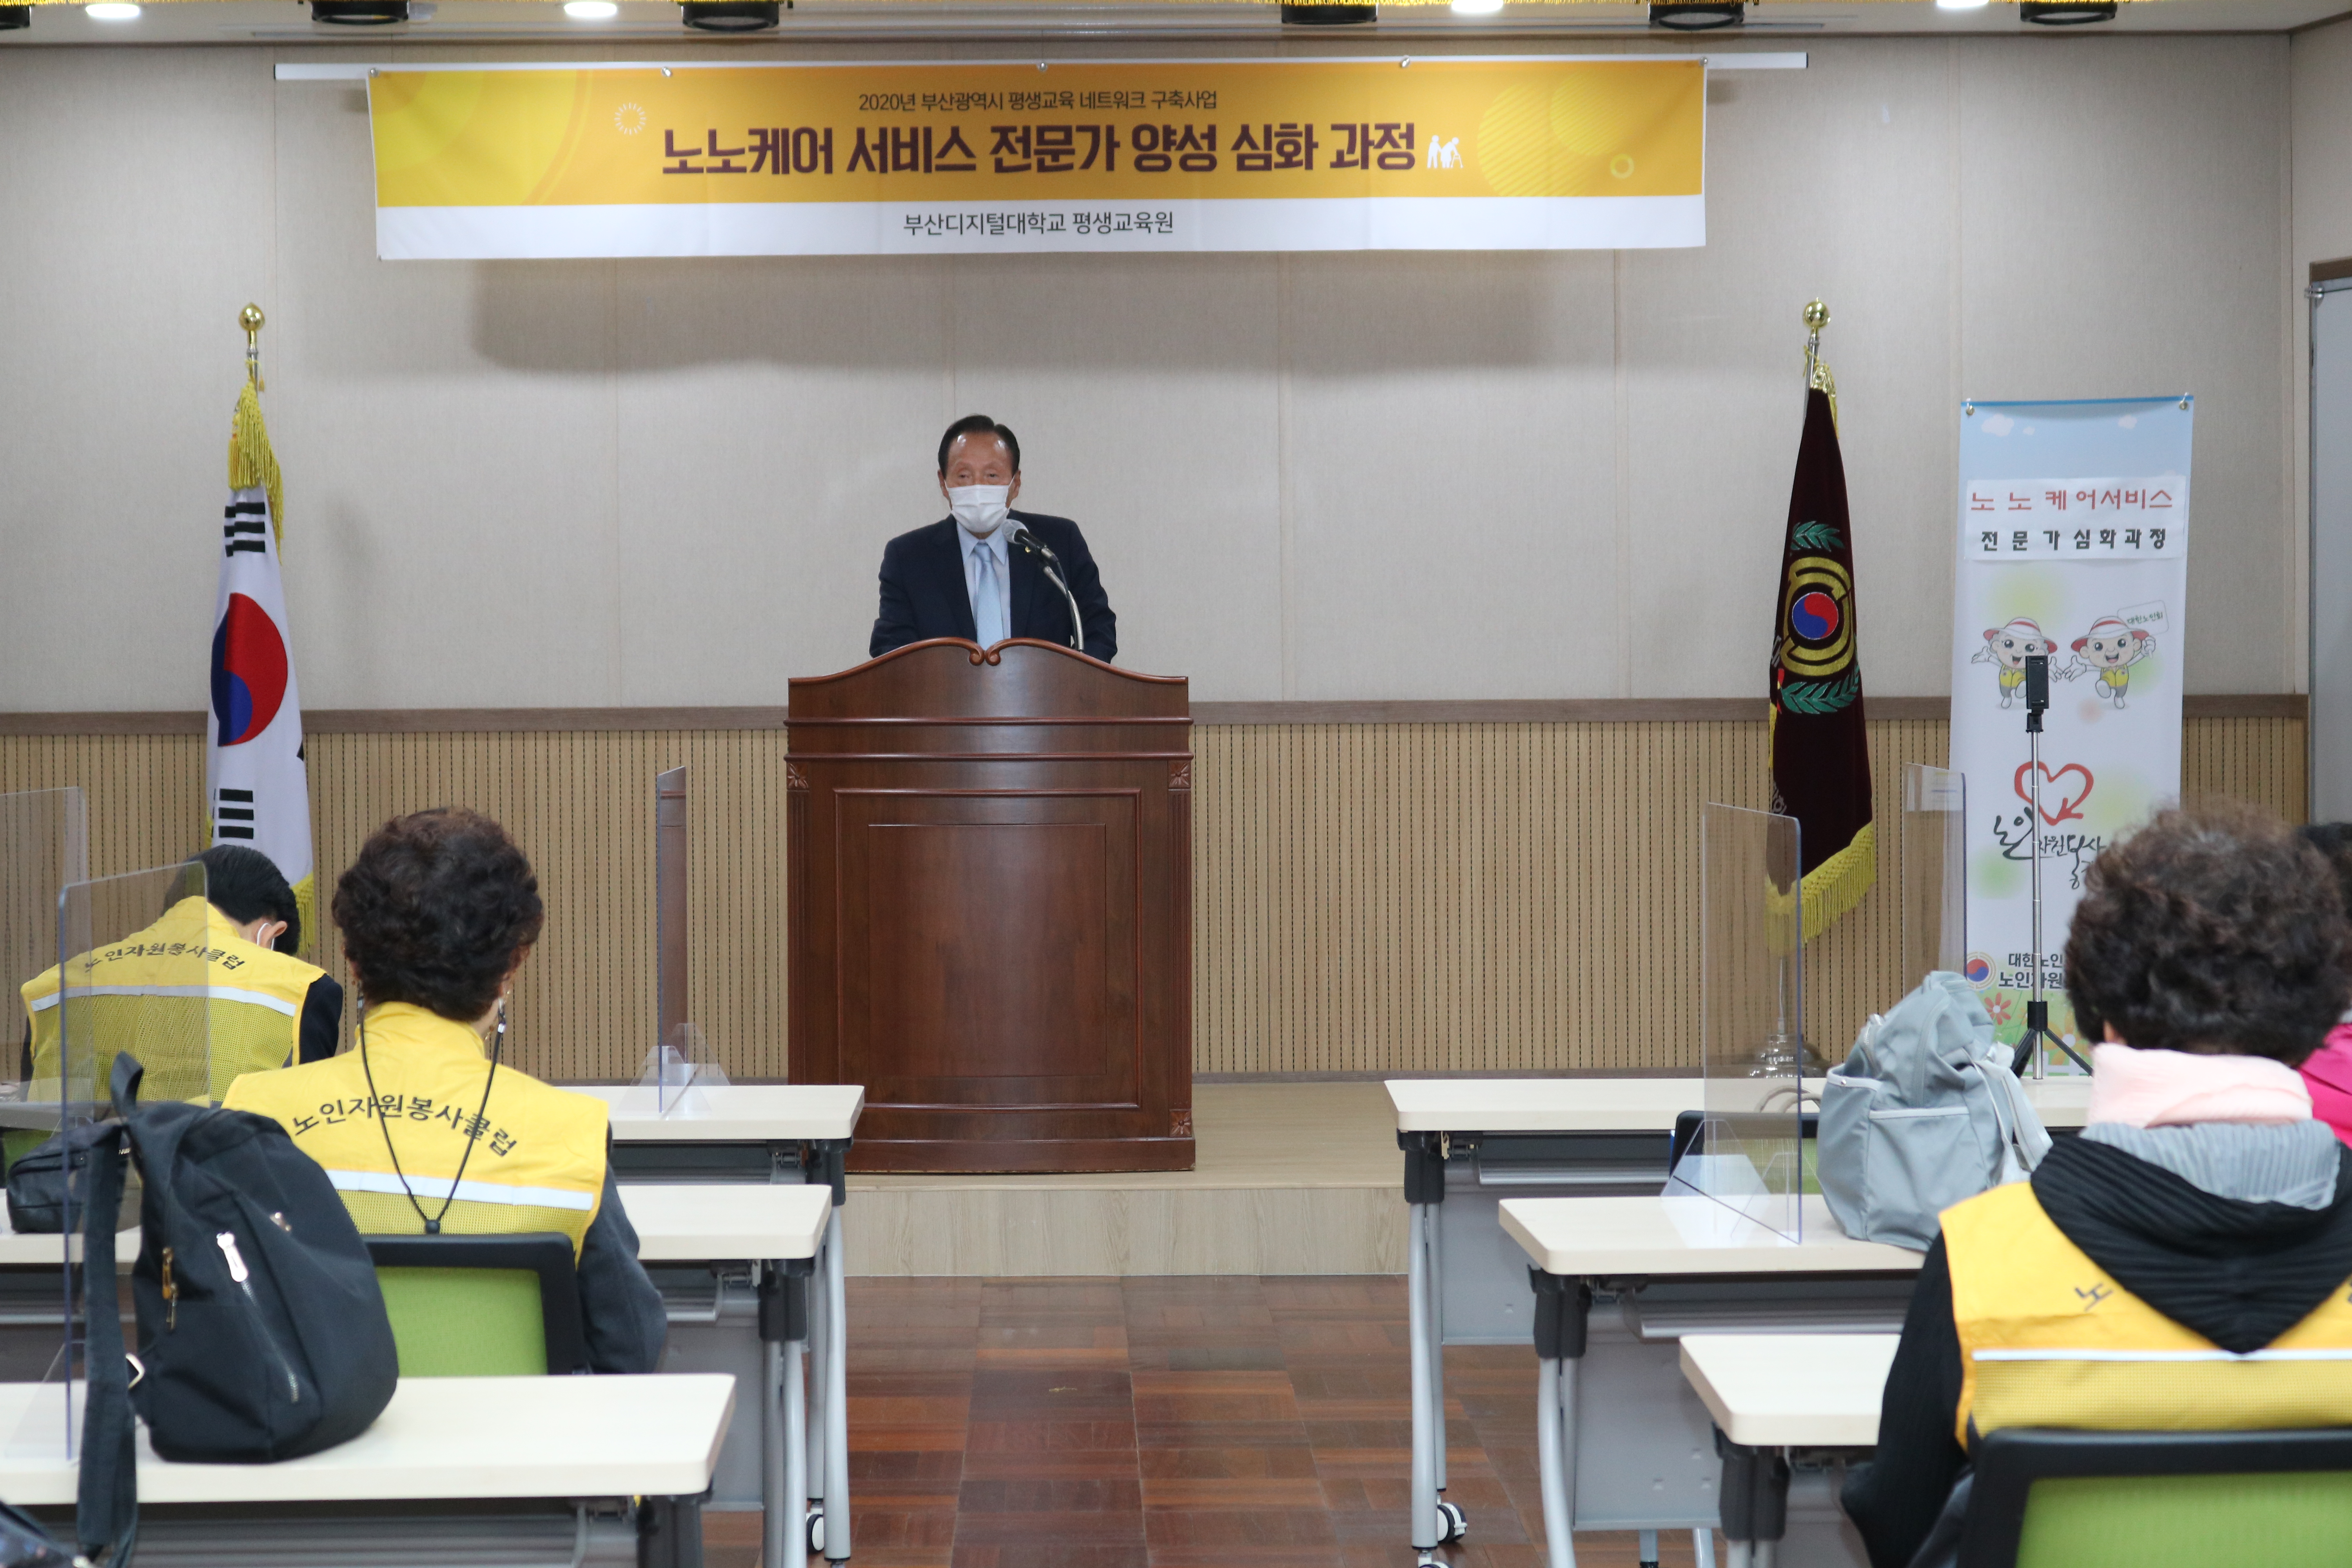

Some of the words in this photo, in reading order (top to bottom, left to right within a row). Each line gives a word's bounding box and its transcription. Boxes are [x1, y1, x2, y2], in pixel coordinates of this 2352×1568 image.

[859, 93, 916, 111] 2020년
[921, 92, 1003, 111] 부산광역시
[1008, 91, 1074, 110] 평생교육
[1080, 91, 1146, 109] 네트워크
[1151, 90, 1217, 109] 구축사업
[662, 127, 833, 174] 노노케어
[846, 126, 976, 174] 서비스
[989, 125, 1120, 173] 전문가
[1132, 123, 1218, 172] 양성
[1230, 123, 1319, 171] 심화
[1330, 122, 1415, 170] 과정
[904, 212, 1066, 236] 부산디지털대학교
[1072, 211, 1173, 234] 평생교육원
[84, 942, 246, 973] 노인자원봉사클럽
[292, 1094, 517, 1157] 노인자원봉사클럽
